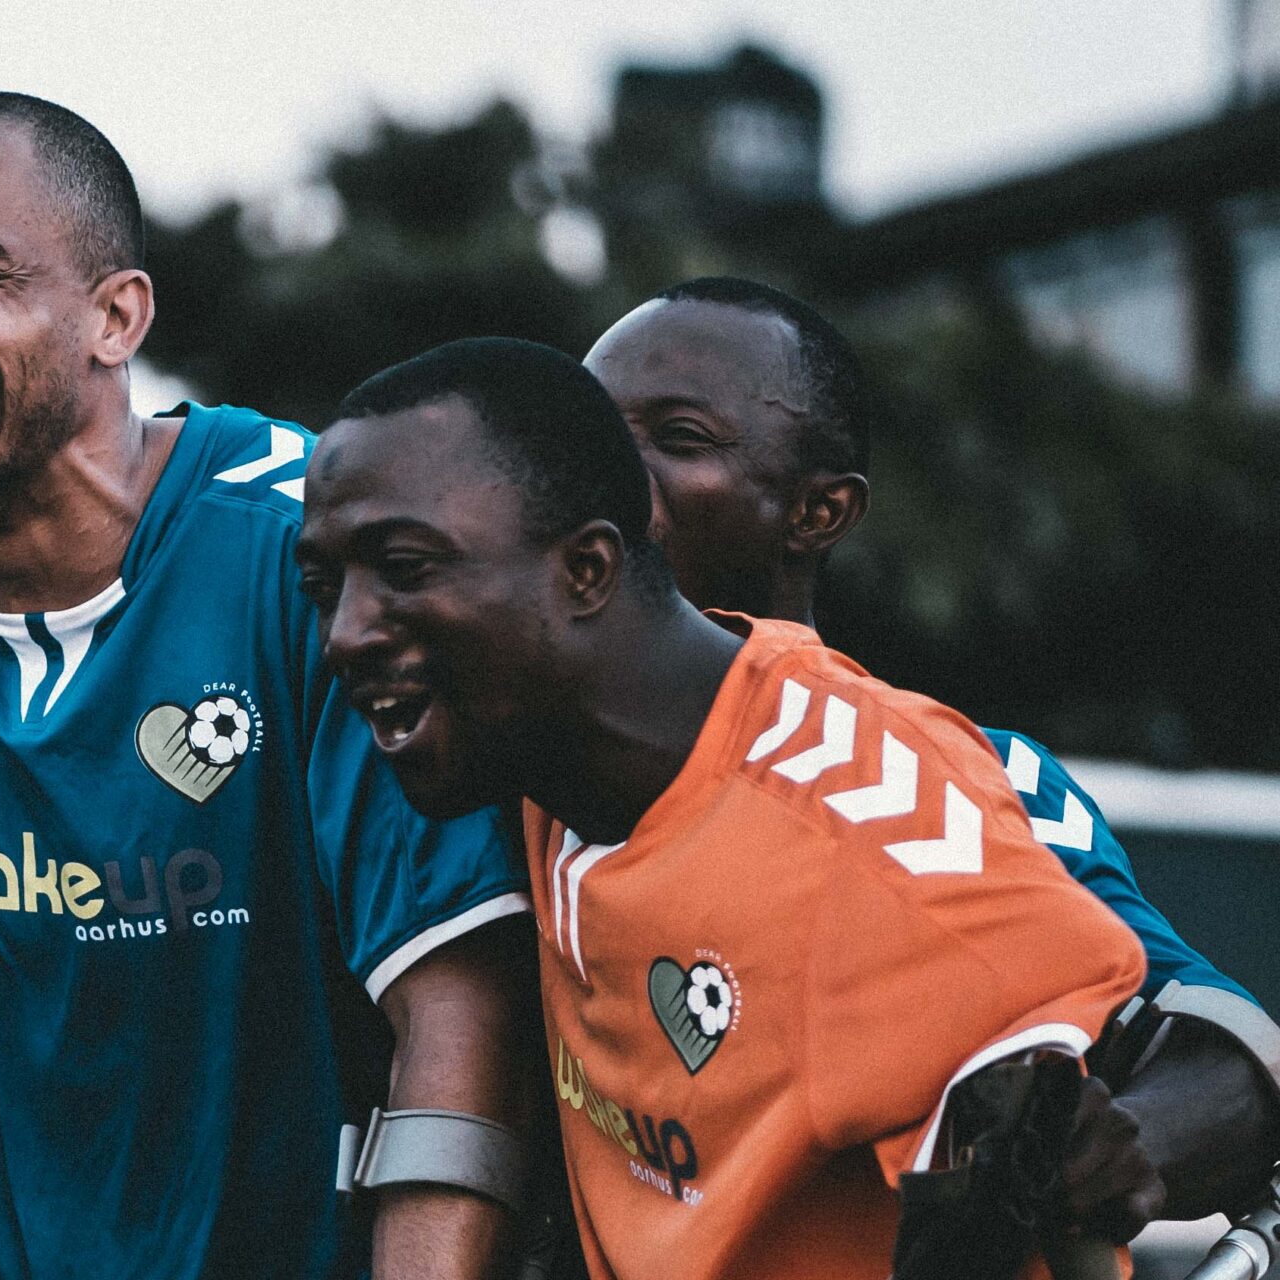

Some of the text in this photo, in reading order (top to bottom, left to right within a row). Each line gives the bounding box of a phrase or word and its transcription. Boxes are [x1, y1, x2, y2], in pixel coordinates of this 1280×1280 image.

[202, 681, 264, 753] DEAR FOOTBALL
[74, 917, 168, 942] aarhus
